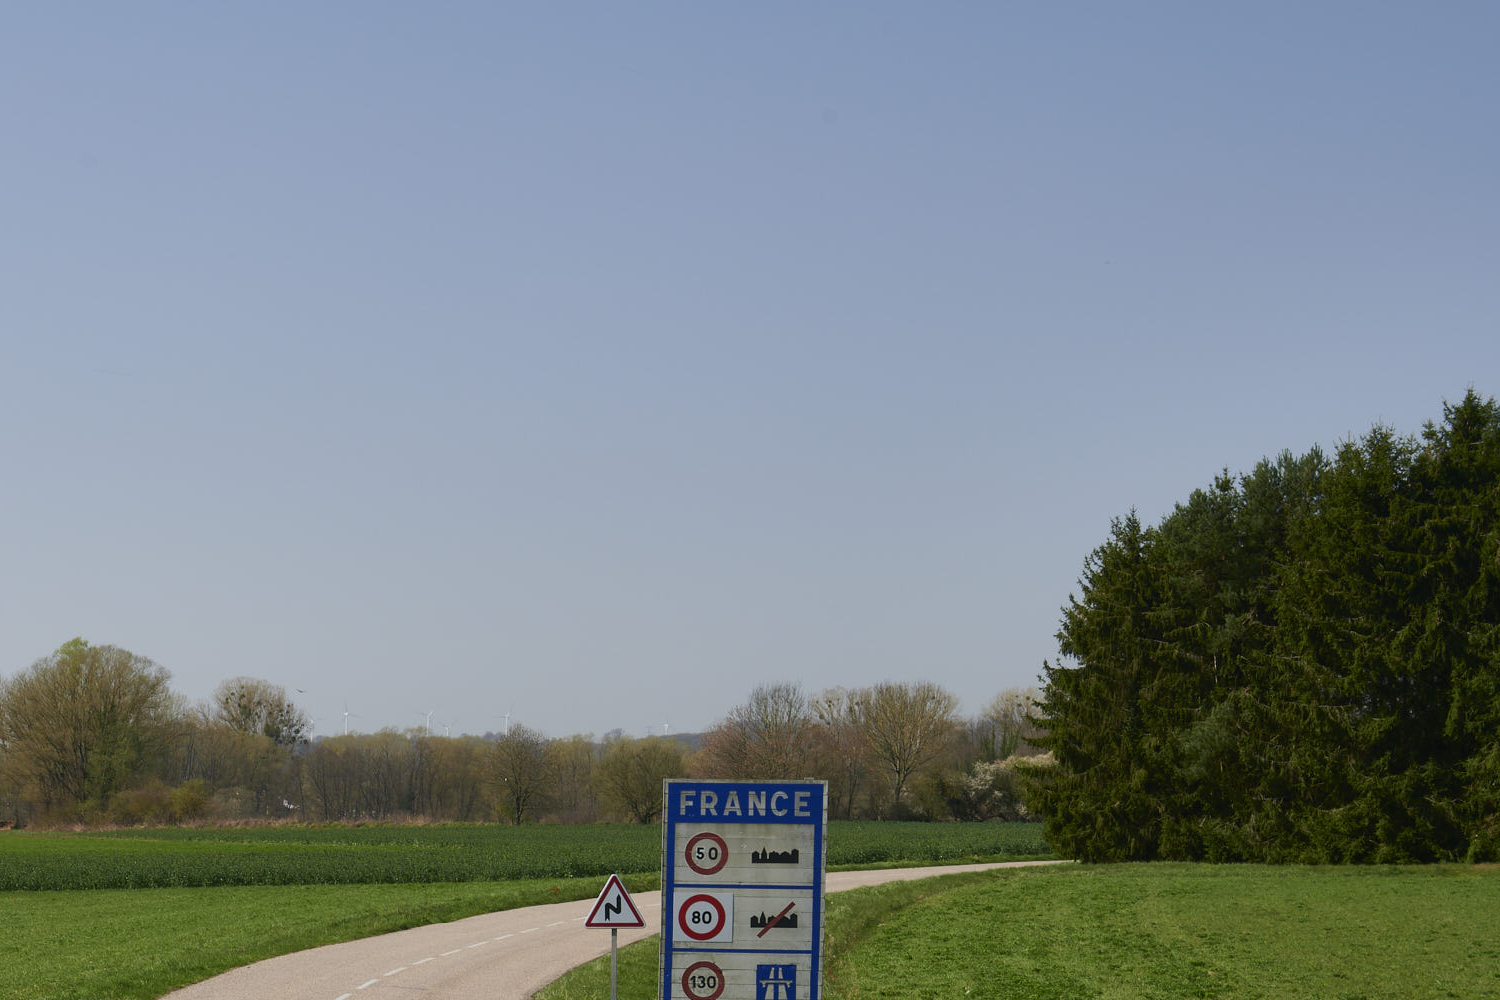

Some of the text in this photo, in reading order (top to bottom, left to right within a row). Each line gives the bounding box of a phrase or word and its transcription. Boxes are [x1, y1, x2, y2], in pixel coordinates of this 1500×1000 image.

[679, 790, 811, 817] FRANCE
[696, 847, 718, 861] 50
[691, 910, 712, 925] 80
[690, 975, 717, 989] 130
